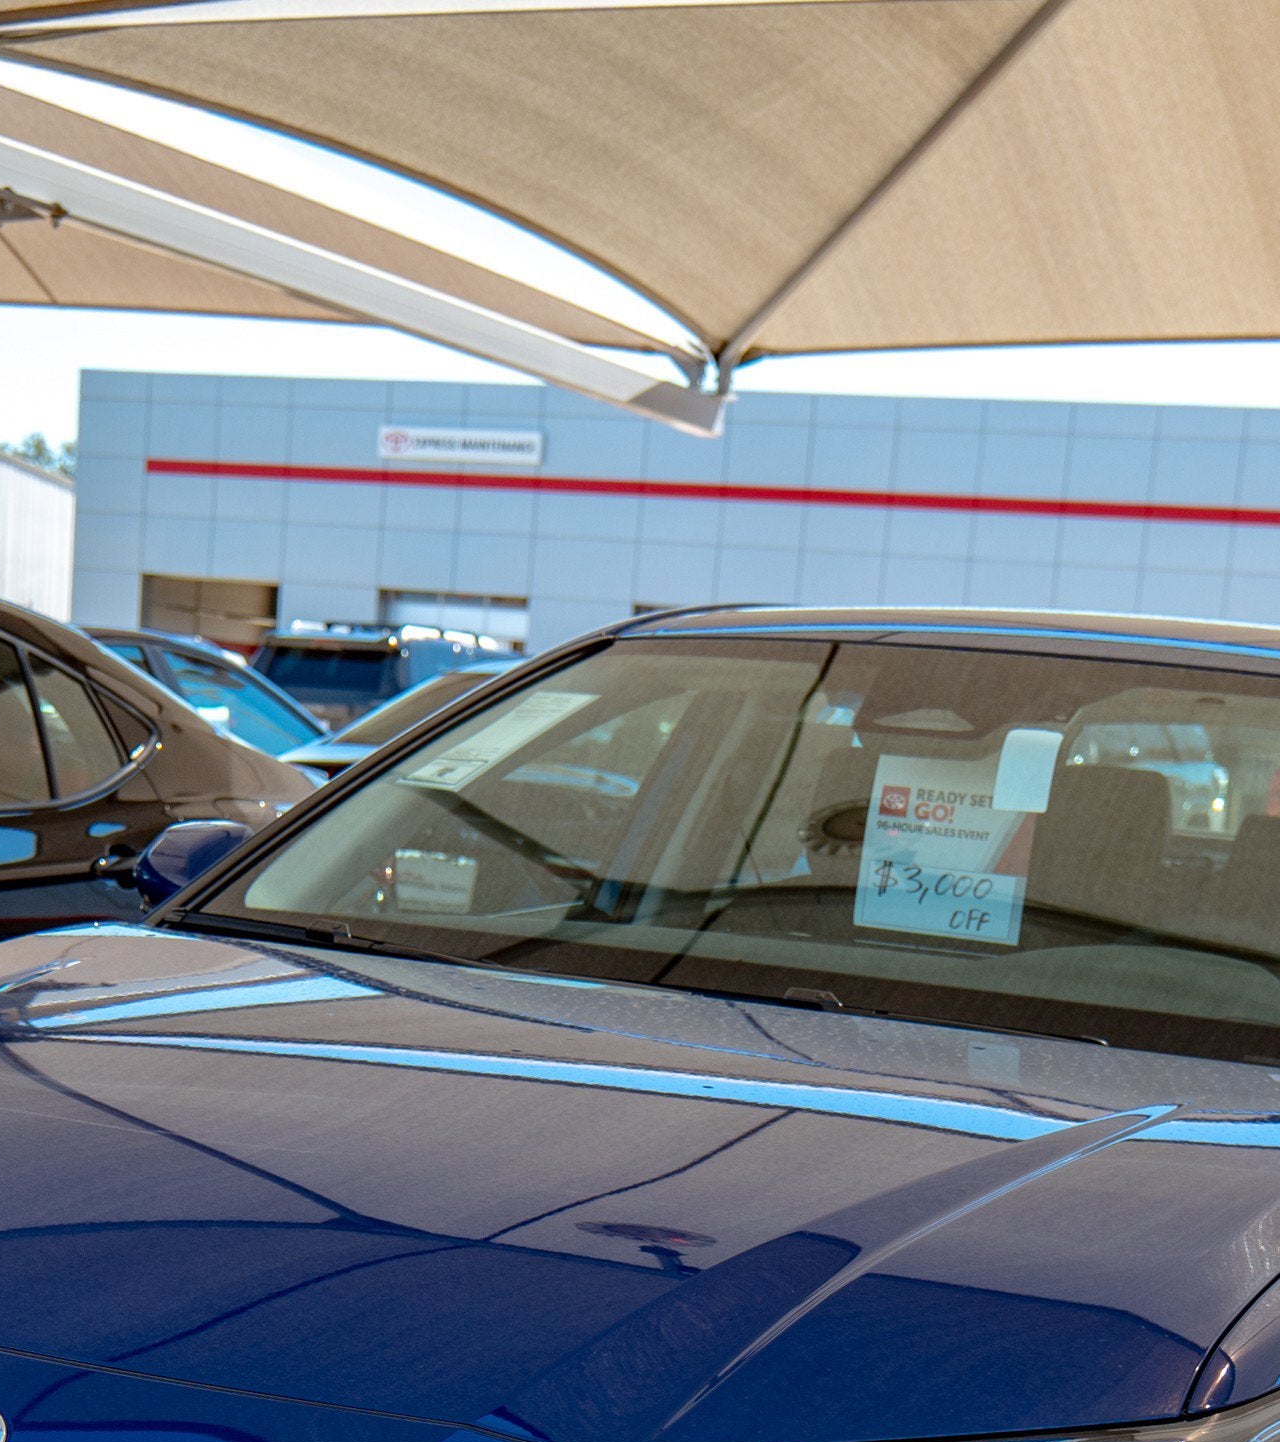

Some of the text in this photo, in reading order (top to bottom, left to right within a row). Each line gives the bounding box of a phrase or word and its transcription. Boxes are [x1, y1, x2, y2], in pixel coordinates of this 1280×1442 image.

[916, 787, 968, 806] READY
[914, 801, 957, 825] GO!
[925, 825, 957, 839] SALES
[957, 827, 992, 842] EVENT
[872, 859, 994, 905] $3,000
[948, 908, 992, 932] OFF
